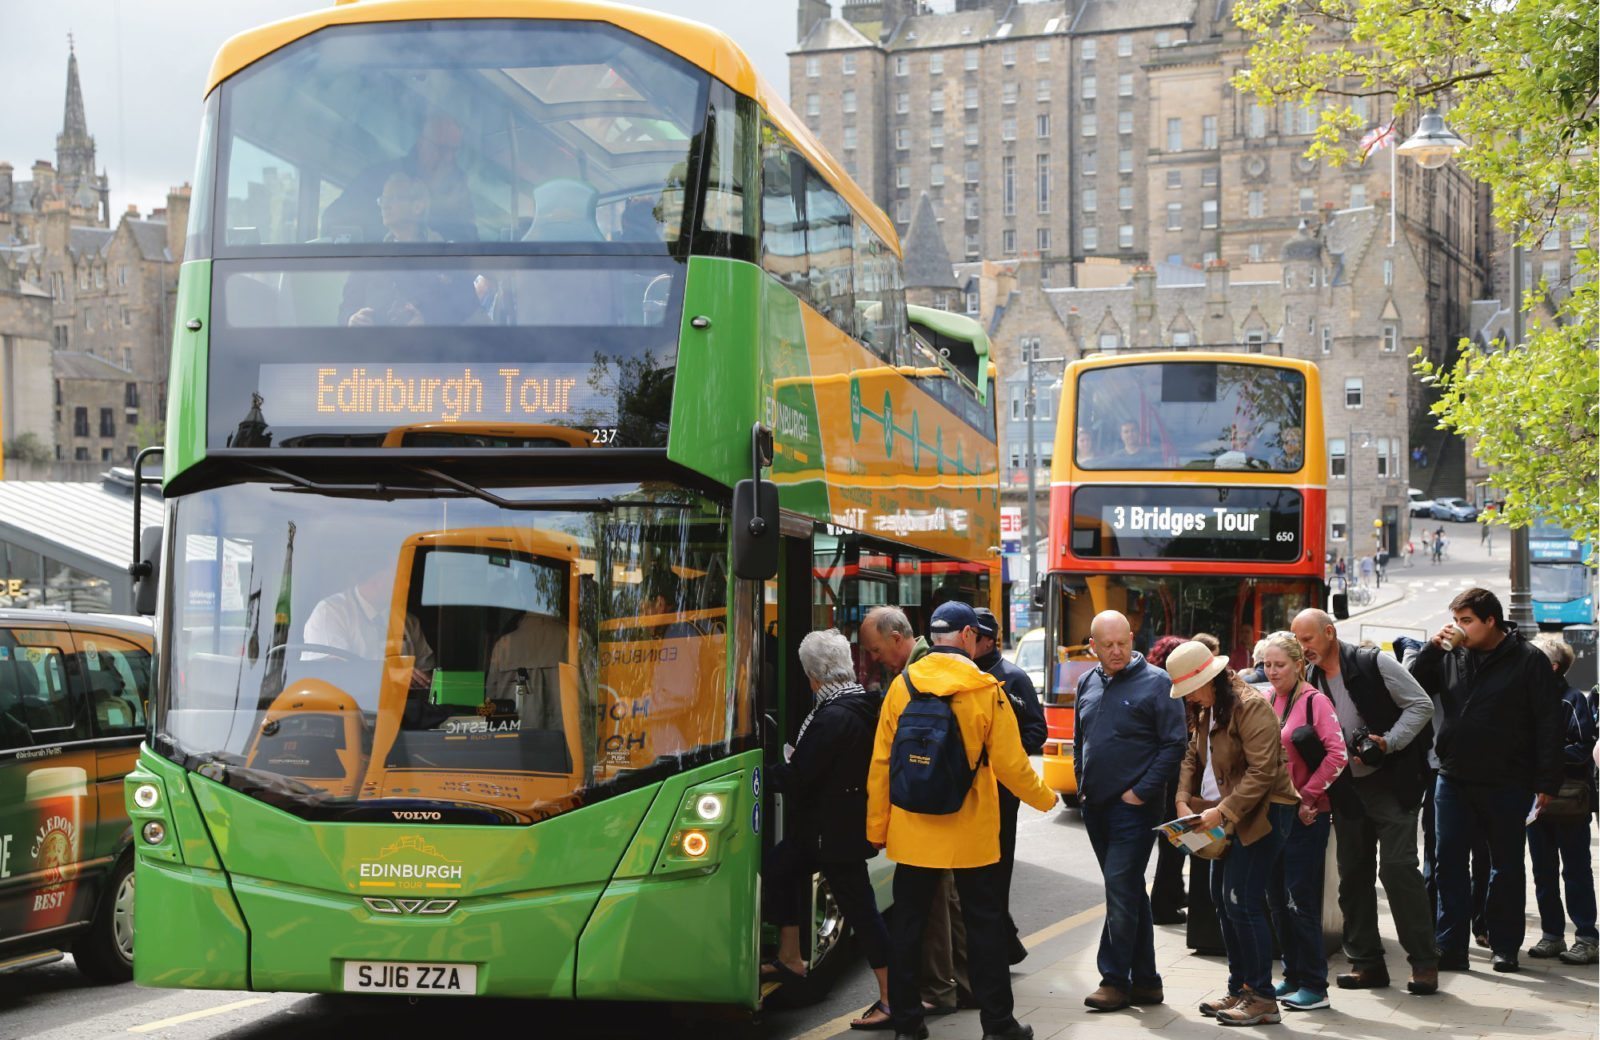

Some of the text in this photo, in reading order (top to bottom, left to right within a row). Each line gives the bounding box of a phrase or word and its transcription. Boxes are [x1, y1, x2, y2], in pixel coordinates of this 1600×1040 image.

[316, 368, 577, 422] Edinburgh Tour
[766, 396, 808, 443] EDINBURGH
[592, 428, 617, 443] 237
[1113, 507, 1260, 536] 3 Bridges Tour
[1276, 531, 1294, 542] 650
[392, 811, 441, 820] VOLVO
[0, 834, 13, 878] E
[360, 863, 462, 879] EDINBURGH
[399, 881, 423, 889] TOUR
[33, 892, 65, 912] BEST
[358, 965, 461, 990] SJ16 ZZA
